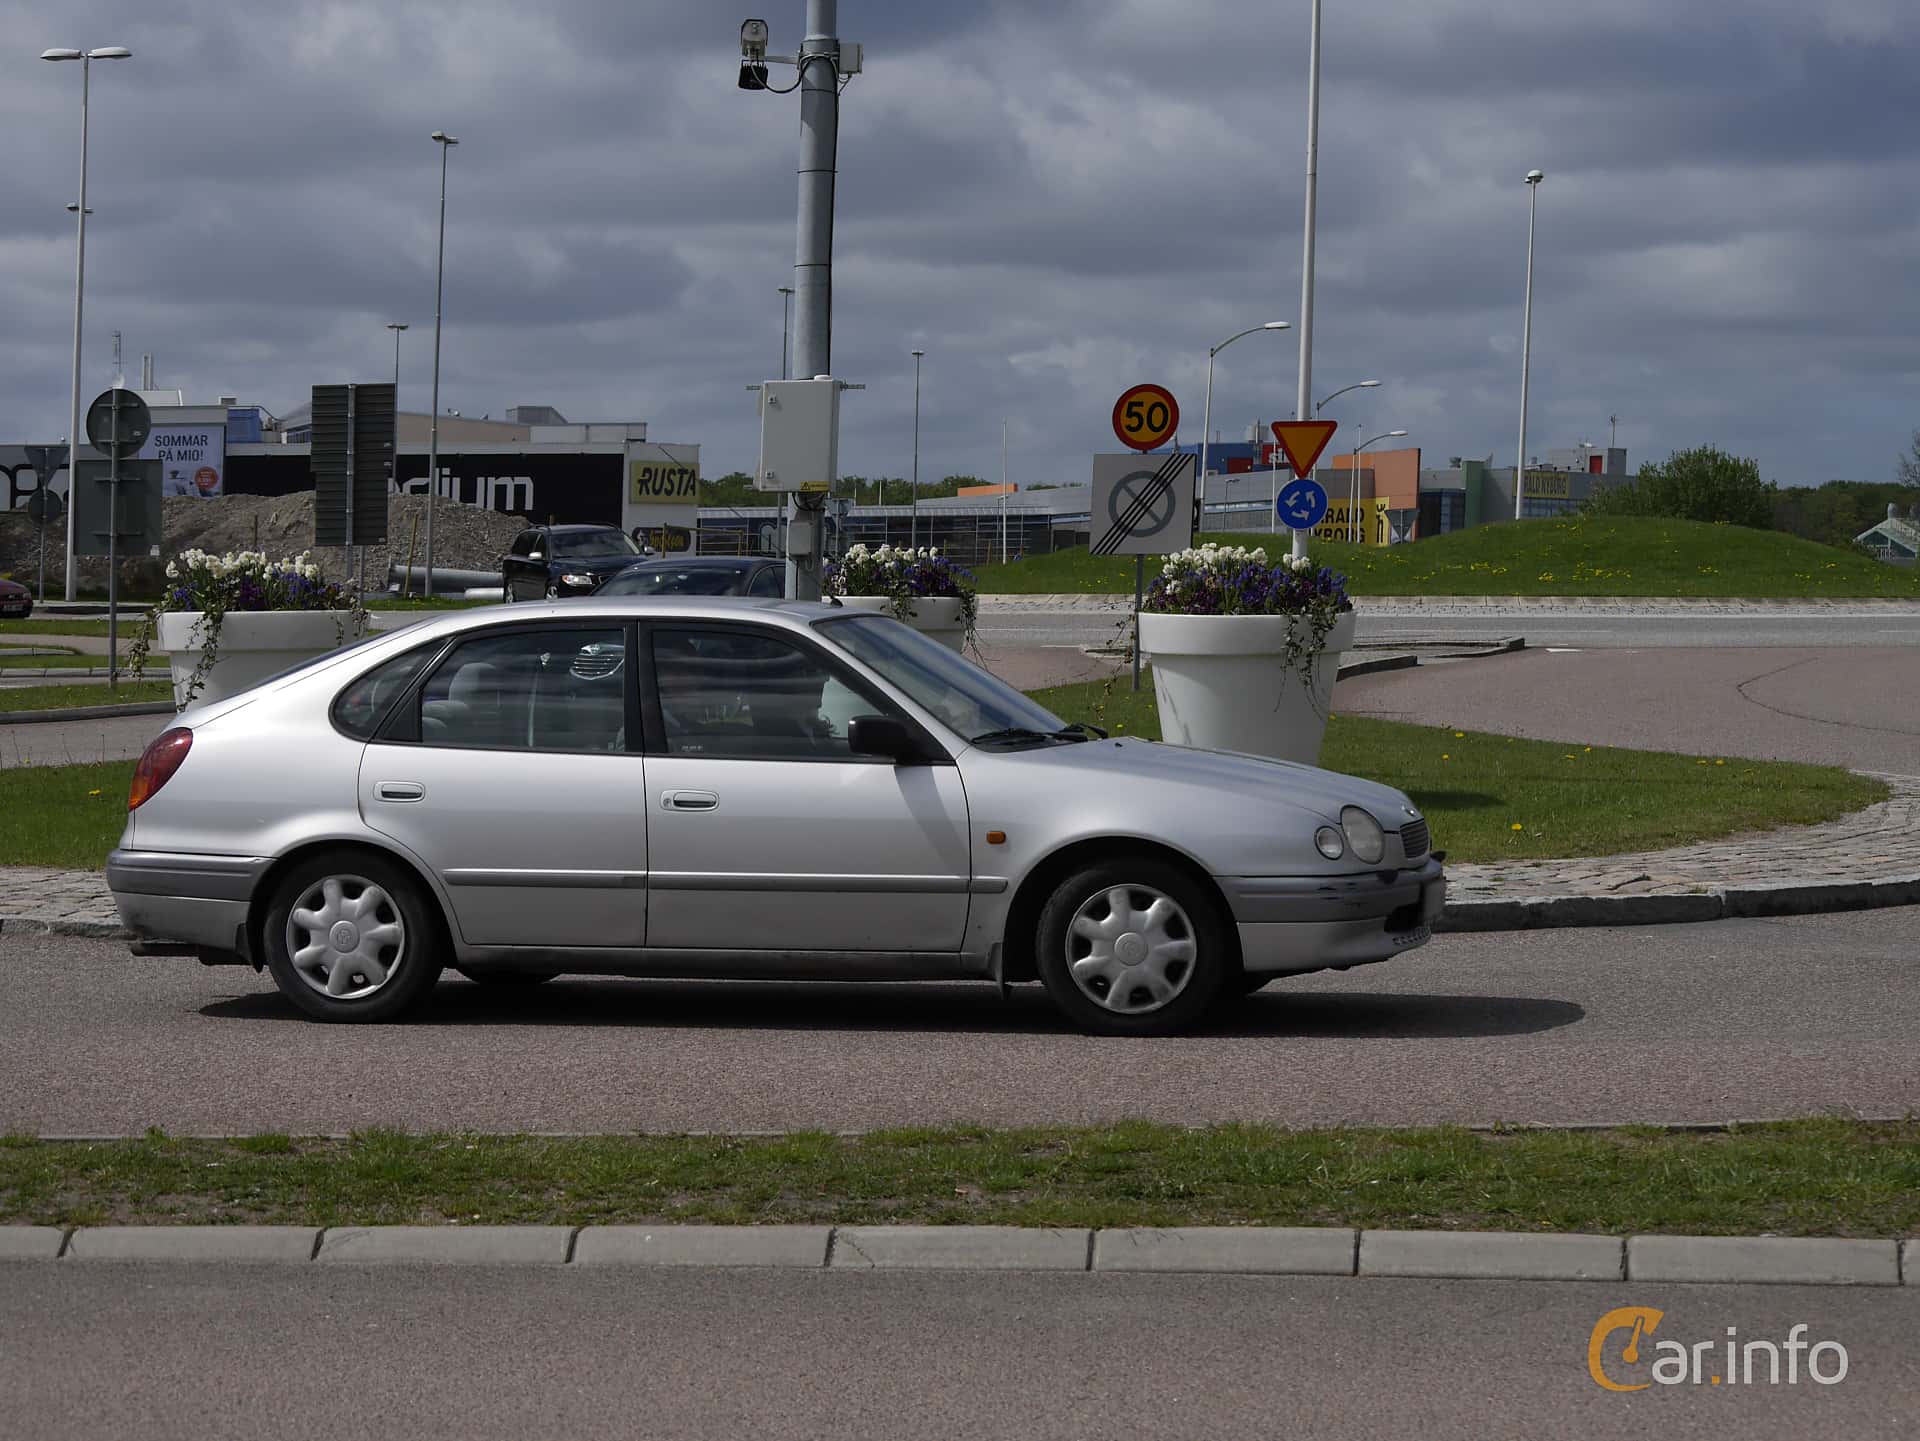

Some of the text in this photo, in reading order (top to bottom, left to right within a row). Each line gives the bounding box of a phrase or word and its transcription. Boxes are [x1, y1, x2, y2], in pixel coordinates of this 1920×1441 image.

[1125, 401, 1169, 433] 50
[154, 434, 208, 447] SOMMAR
[177, 449, 203, 462] MIO!
[637, 466, 697, 497] RUSTA
[1321, 507, 1365, 524] RALD
